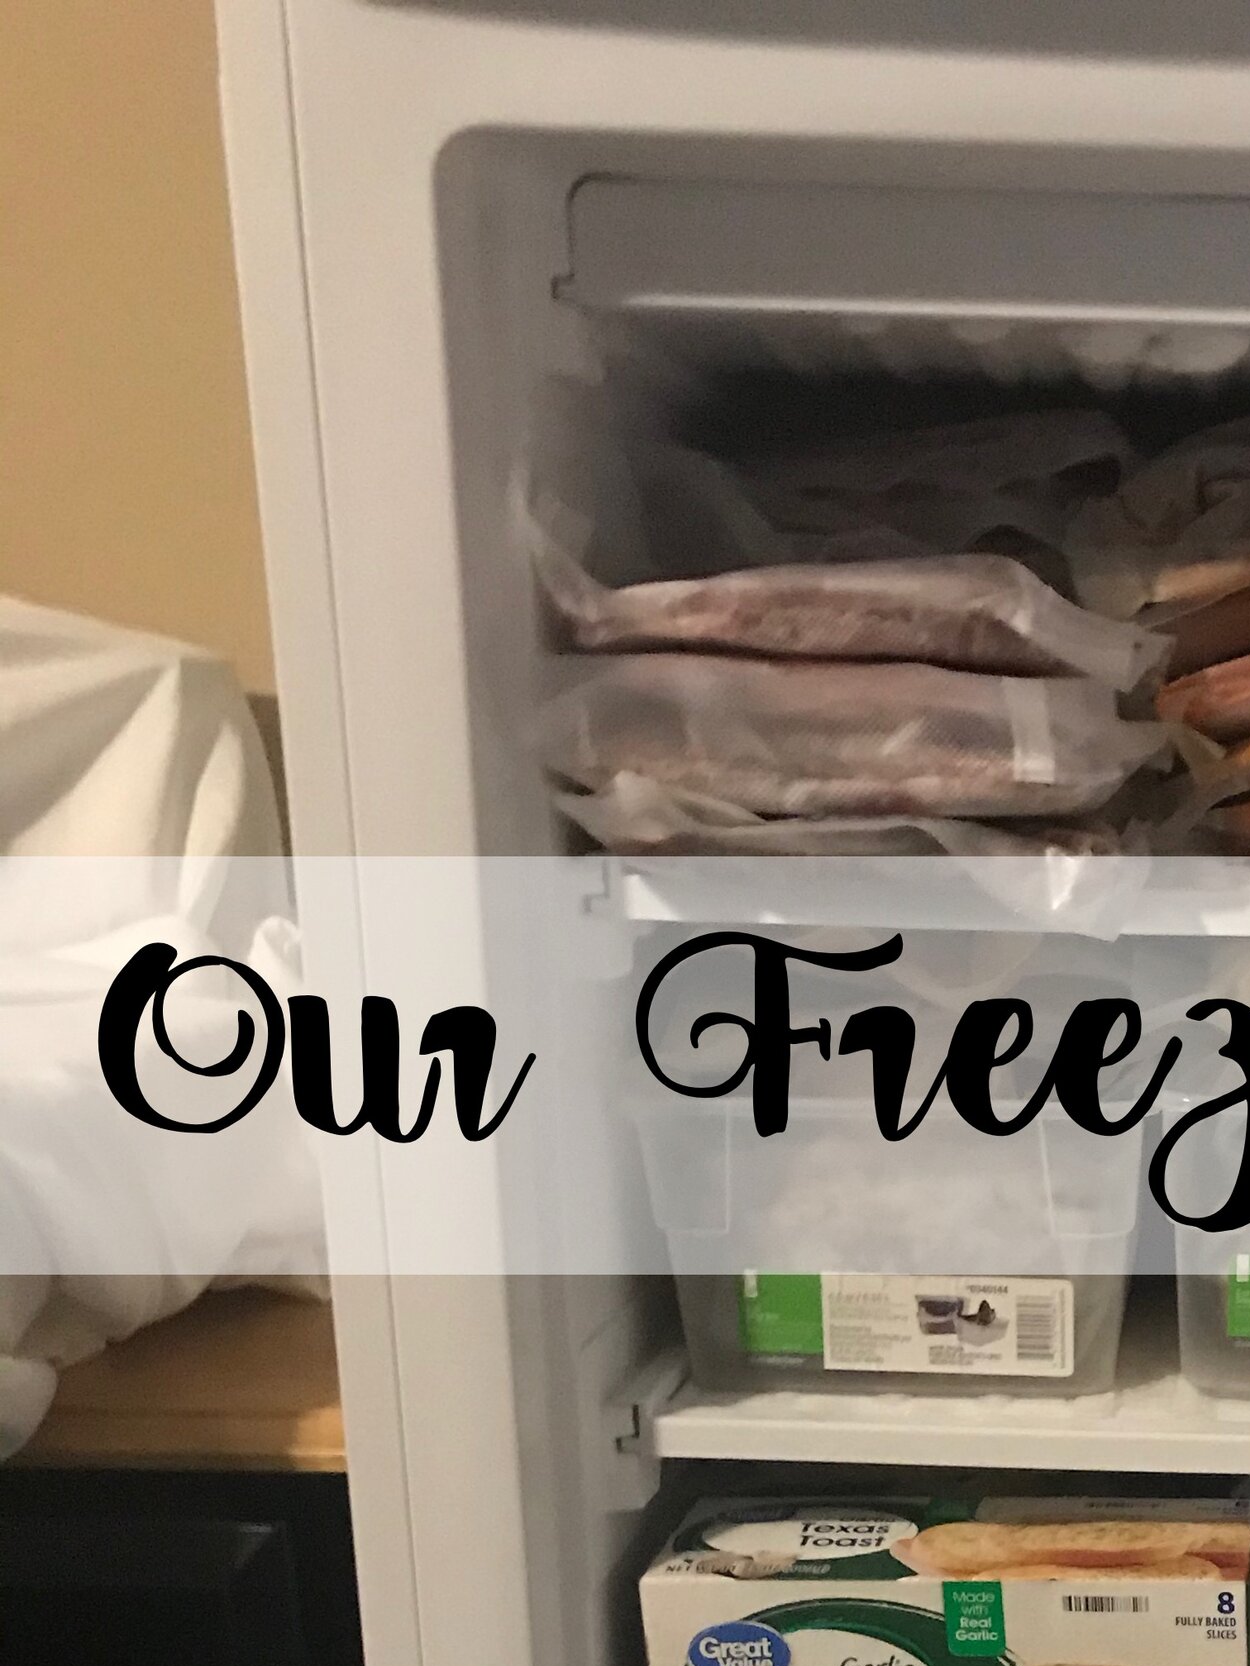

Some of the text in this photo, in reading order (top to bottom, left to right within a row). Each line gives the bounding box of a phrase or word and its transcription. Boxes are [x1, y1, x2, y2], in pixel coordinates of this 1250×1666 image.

[800, 1522, 890, 1534] Texas
[800, 1535, 886, 1547] Toast
[952, 1591, 995, 1603] Made
[1216, 1591, 1236, 1614] 8
[961, 1604, 989, 1616] with
[960, 1617, 992, 1628] Real
[1175, 1616, 1237, 1628] FULLY BAKED
[955, 1629, 998, 1641] Garlic
[1206, 1629, 1237, 1640] SLICES
[699, 1637, 773, 1659] Great
